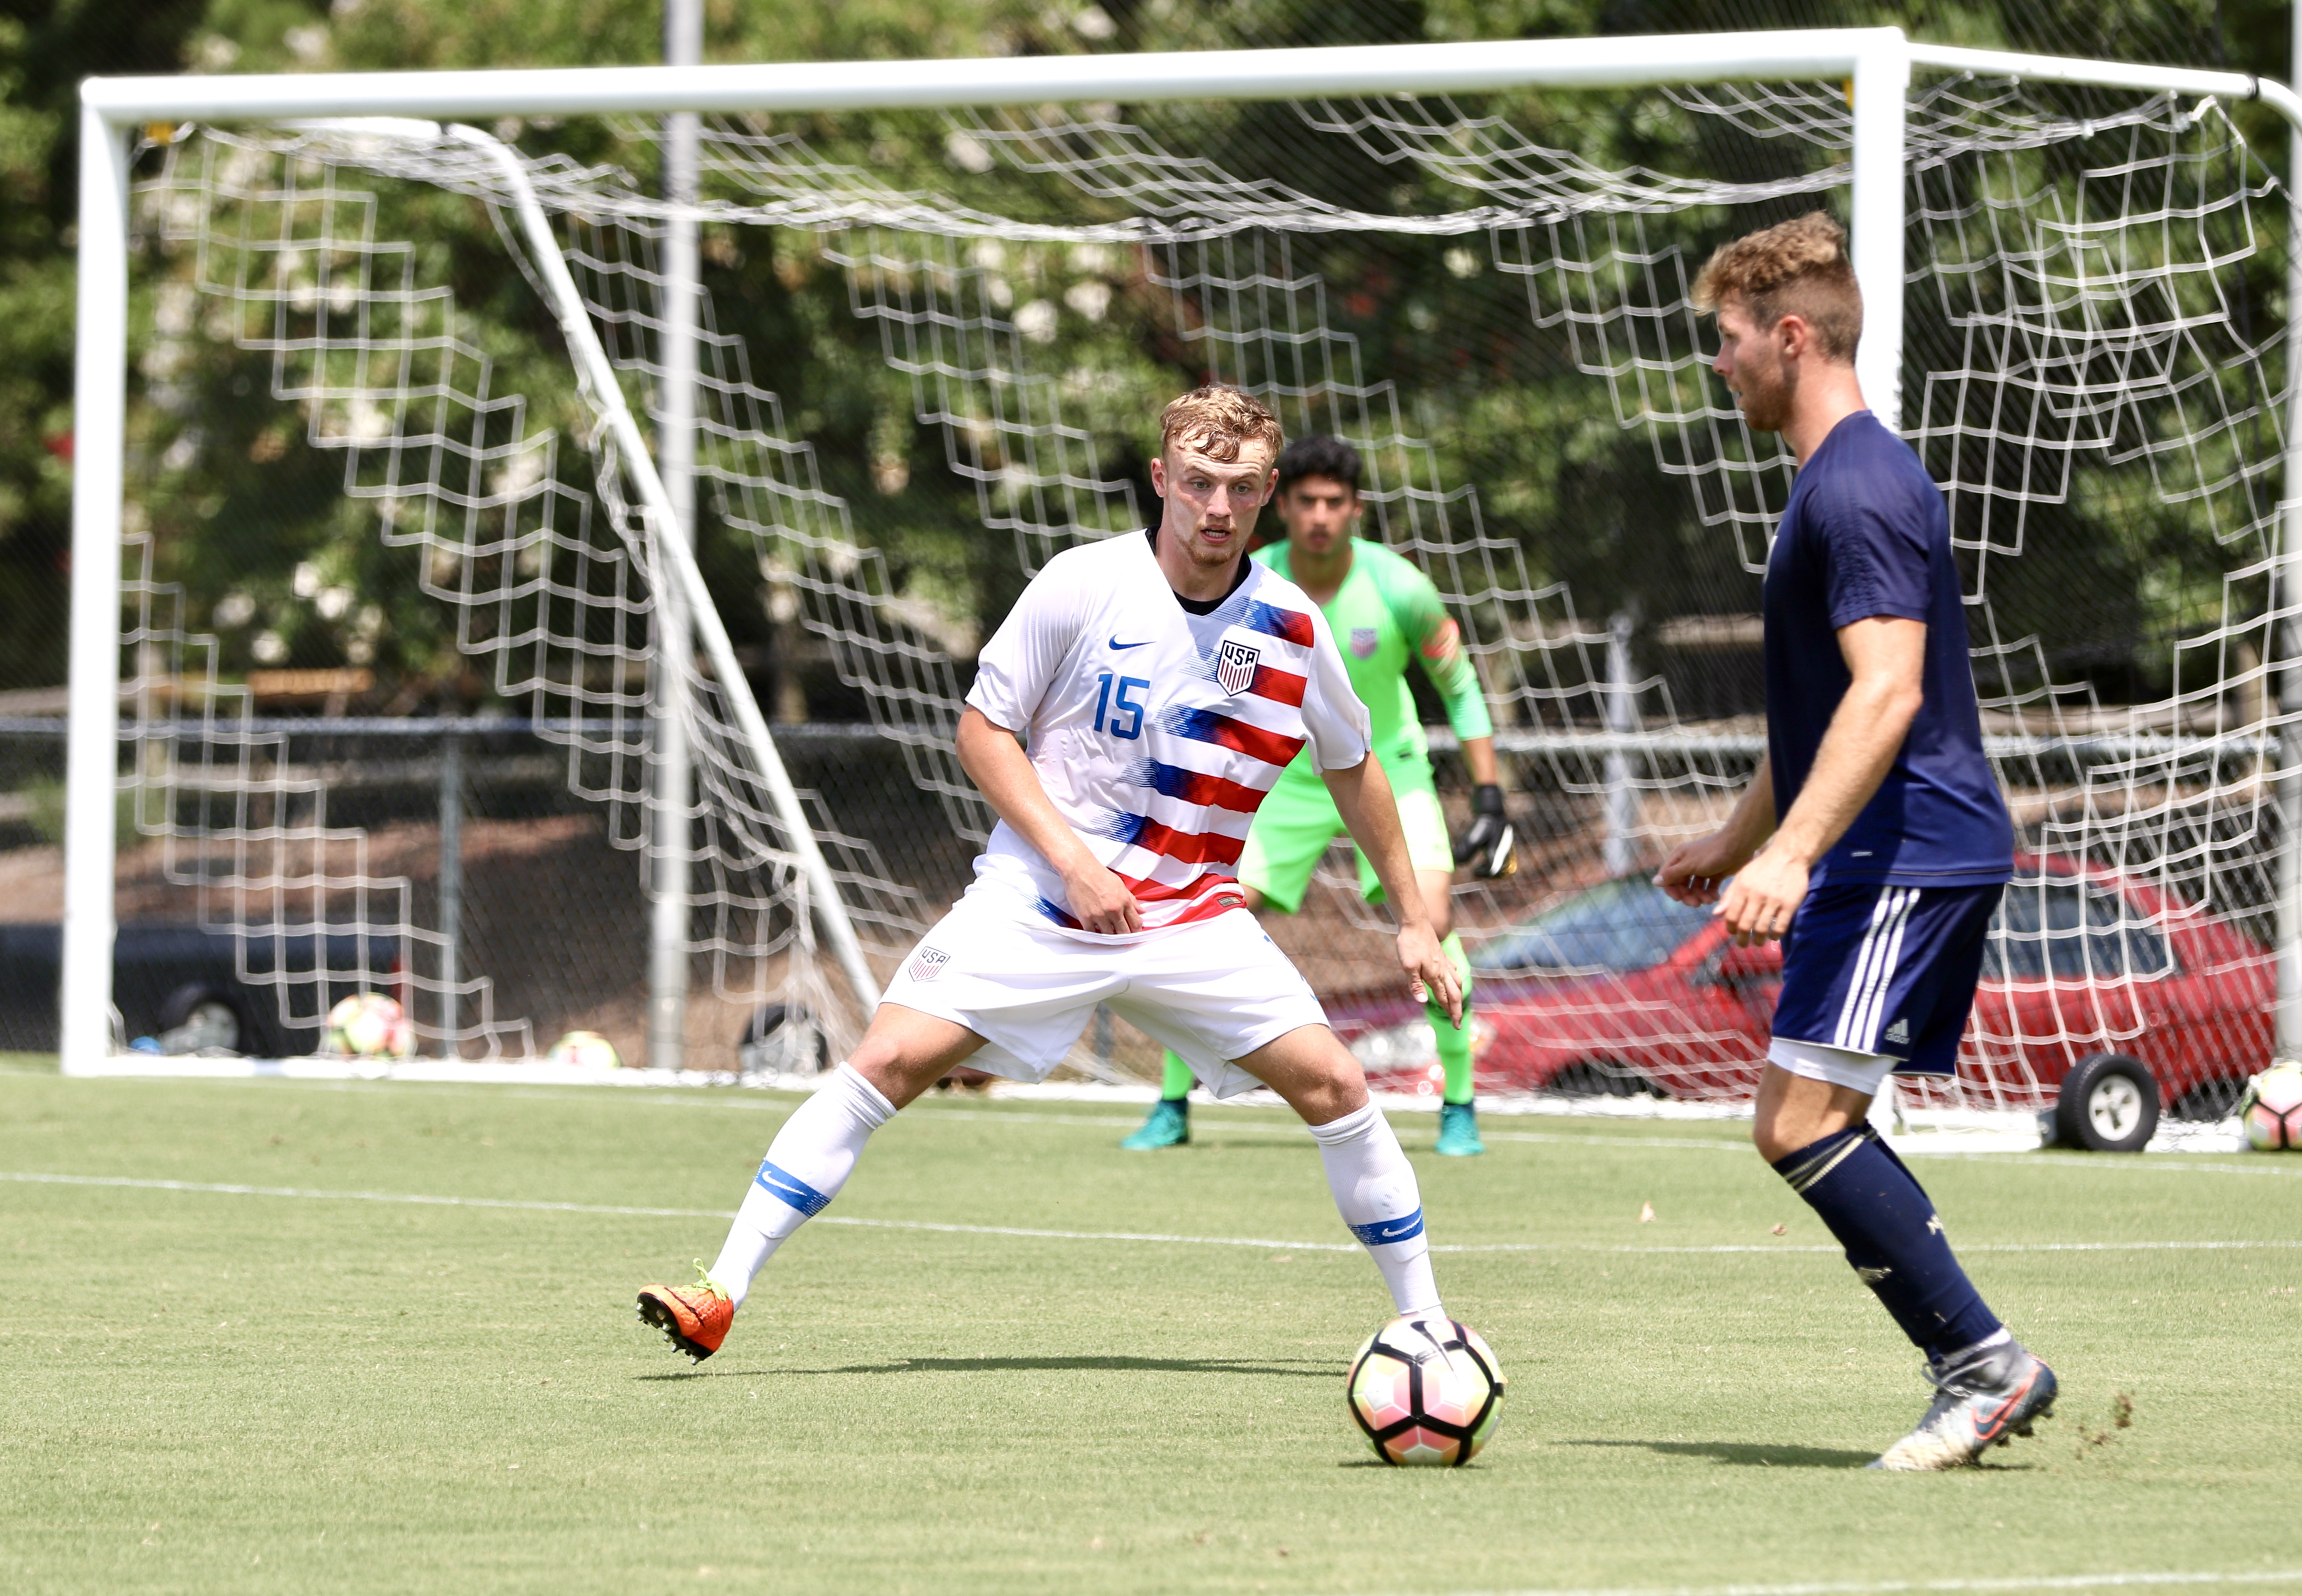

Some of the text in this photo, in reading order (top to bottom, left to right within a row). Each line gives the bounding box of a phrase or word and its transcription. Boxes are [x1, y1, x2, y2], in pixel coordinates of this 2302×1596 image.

[1225, 644, 1256, 666] USA
[1094, 673, 1150, 740] 15
[921, 949, 946, 963] USA
